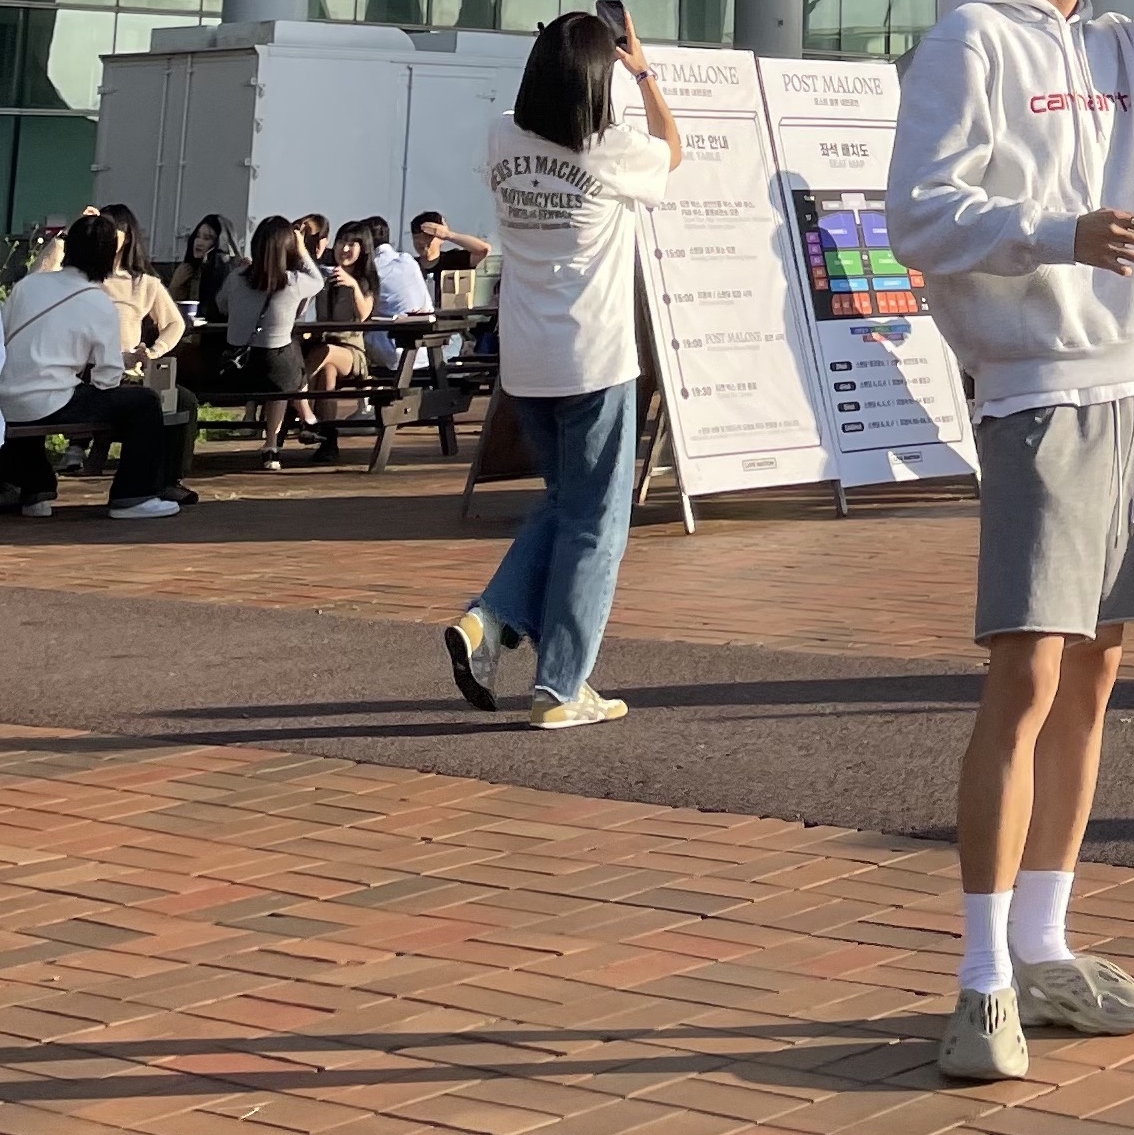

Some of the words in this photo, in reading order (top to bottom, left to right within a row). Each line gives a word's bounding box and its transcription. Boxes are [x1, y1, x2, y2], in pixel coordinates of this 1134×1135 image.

[671, 64, 740, 85] MALONE
[782, 73, 819, 93] POST
[821, 76, 884, 96] MALONE
[685, 134, 706, 150] 시간
[707, 135, 730, 150] 안내
[819, 142, 840, 158] 좌석
[841, 143, 870, 158] 배치도
[513, 155, 532, 176] EX
